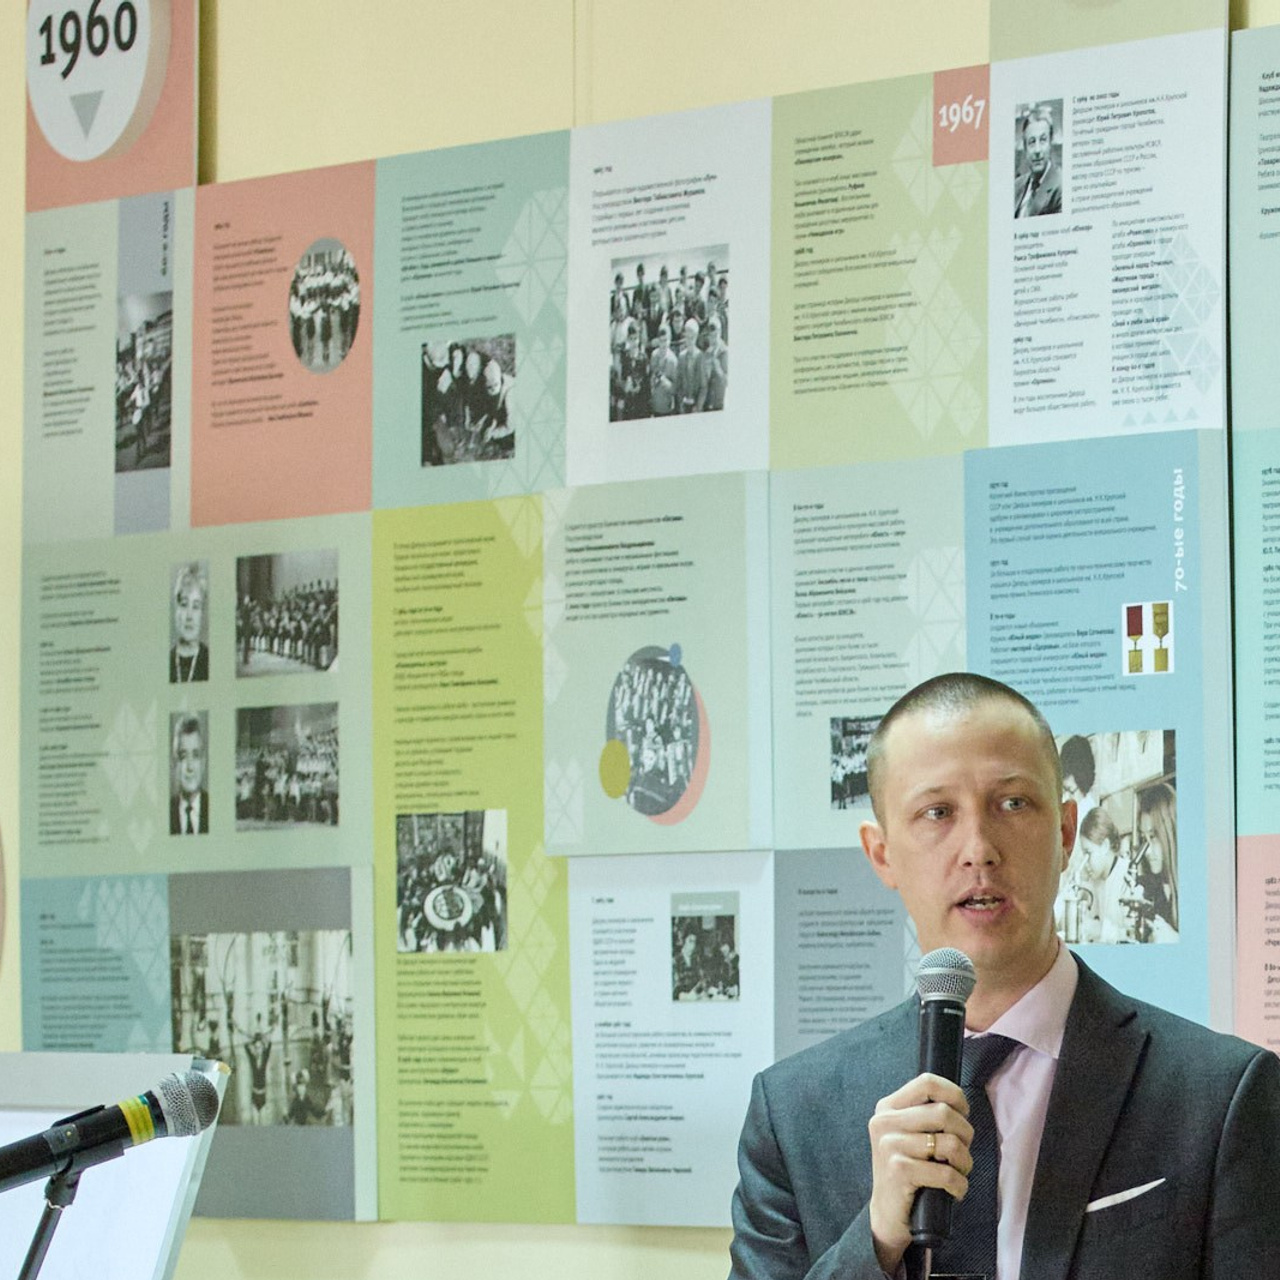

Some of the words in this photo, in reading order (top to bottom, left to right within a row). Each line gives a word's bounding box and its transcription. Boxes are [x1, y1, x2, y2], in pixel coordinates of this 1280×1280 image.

[38, 0, 139, 80] 1960
[937, 95, 986, 134] 1967
[1173, 468, 1185, 522] годы
